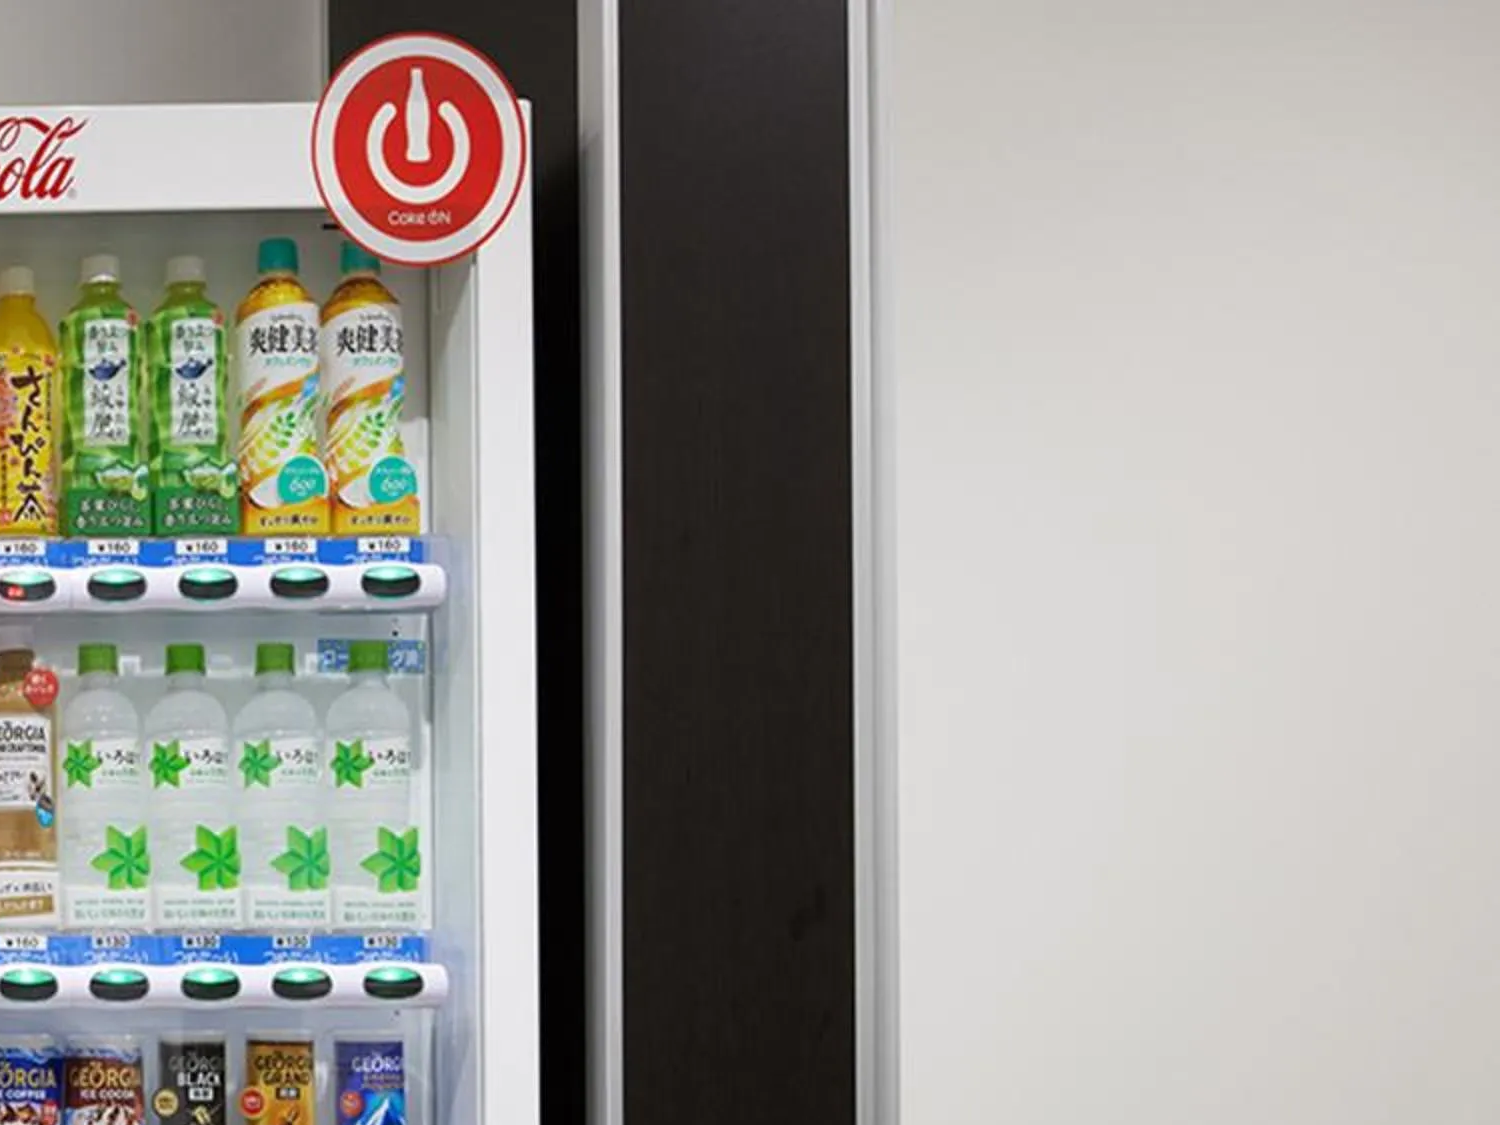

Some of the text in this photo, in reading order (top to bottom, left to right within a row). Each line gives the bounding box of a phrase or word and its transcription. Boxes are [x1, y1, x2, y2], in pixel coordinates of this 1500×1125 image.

[388, 211, 424, 226] Coke
[10, 363, 47, 523] さんぴん茶
[177, 1071, 220, 1087] BLACK
